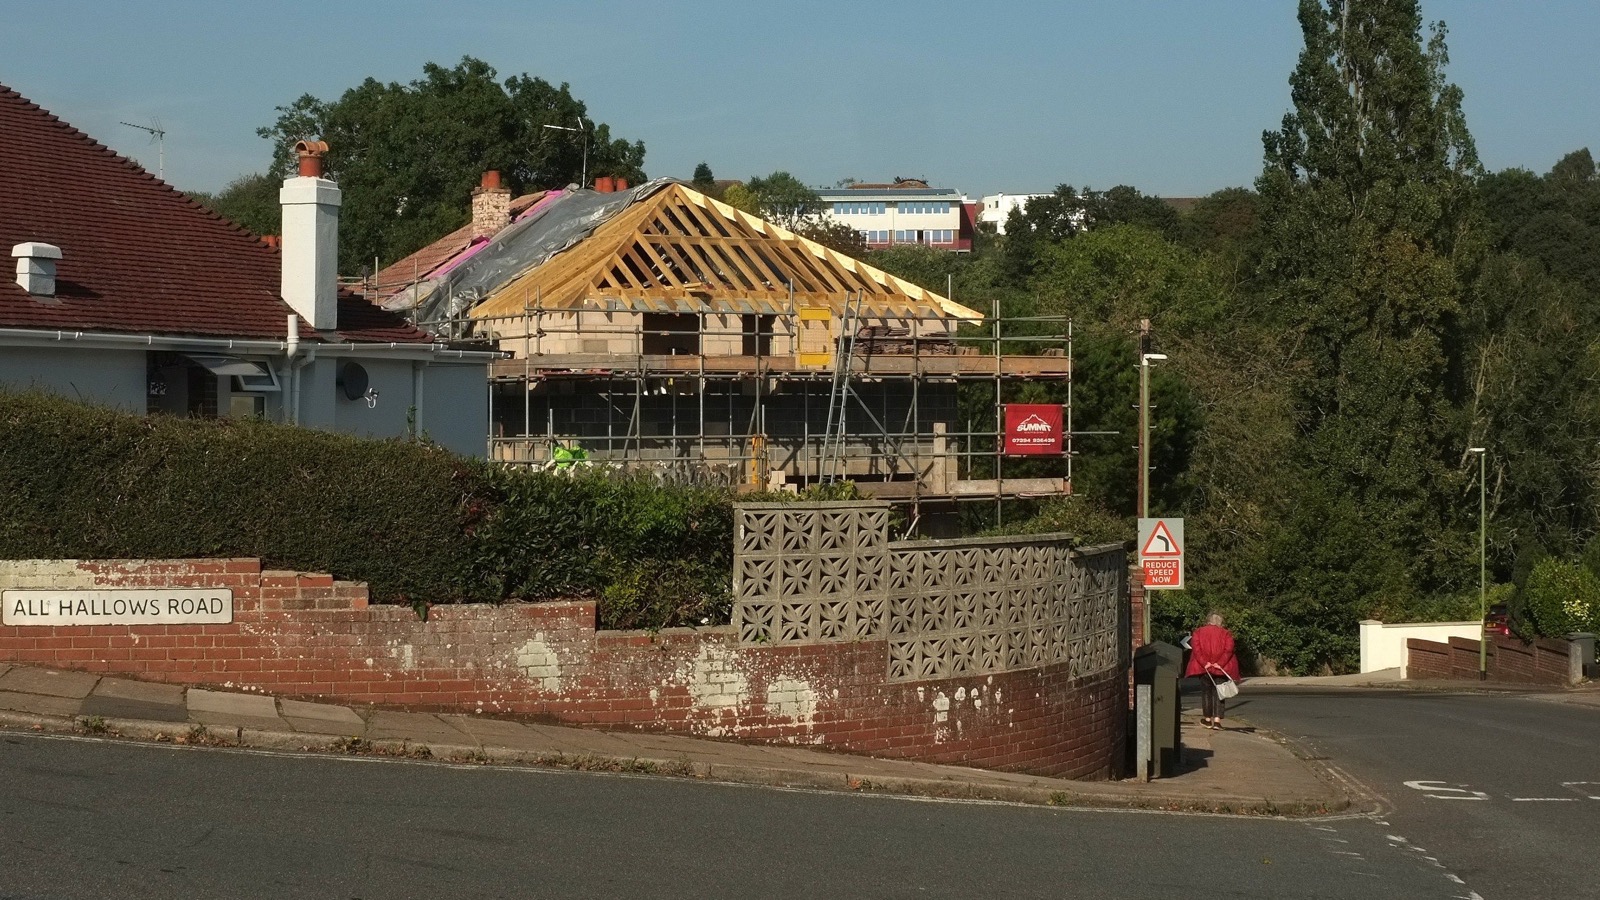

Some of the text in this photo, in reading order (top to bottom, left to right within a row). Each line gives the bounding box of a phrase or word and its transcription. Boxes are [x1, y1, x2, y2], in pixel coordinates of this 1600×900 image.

[1017, 423, 1051, 432] SUMMIT
[13, 598, 223, 616] ALL HALLOWS ROAD
